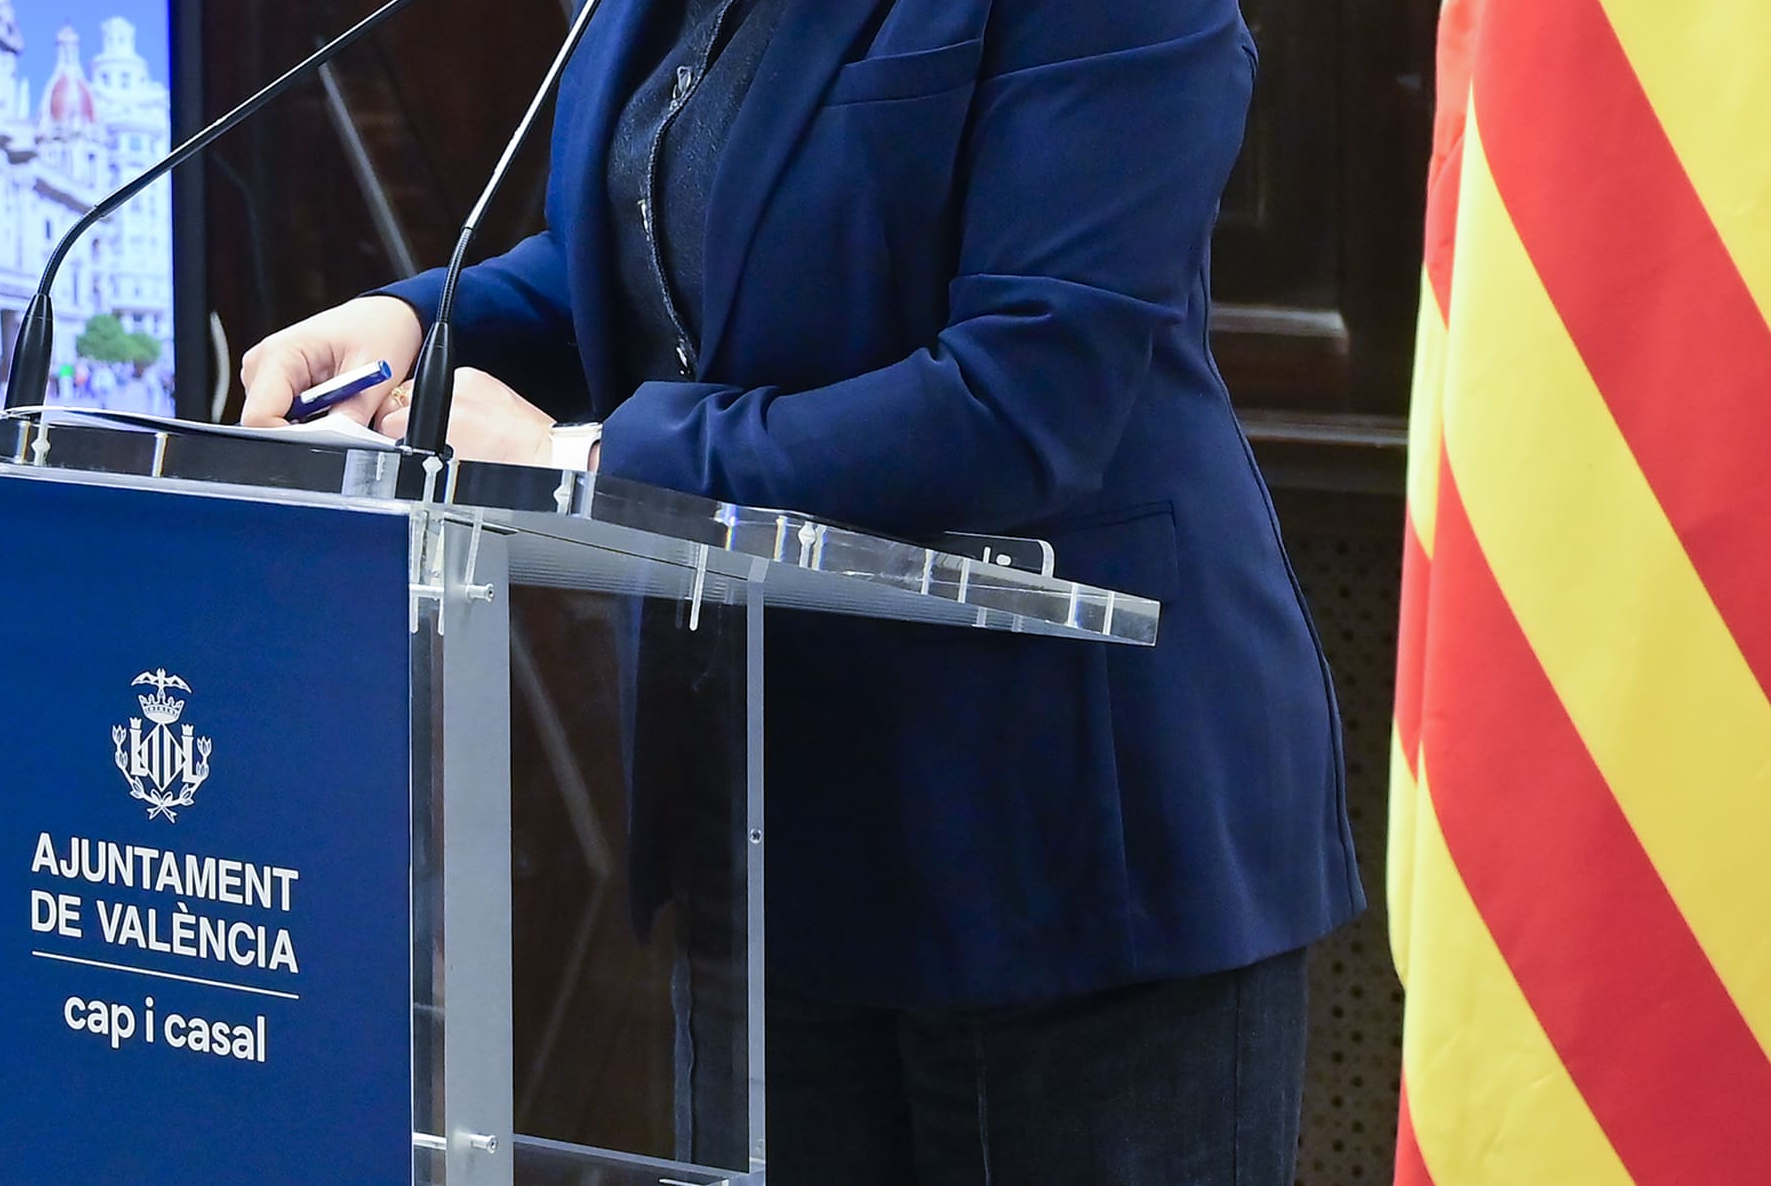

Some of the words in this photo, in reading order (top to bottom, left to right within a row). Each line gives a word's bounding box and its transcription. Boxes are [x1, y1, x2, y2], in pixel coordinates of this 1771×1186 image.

[31, 832, 299, 912] AJUNTAMENT
[31, 889, 83, 939] DE
[96, 900, 300, 974] VALÈNCIA
[64, 995, 135, 1049] cap
[145, 996, 154, 1043] i
[164, 1015, 266, 1063] casal
